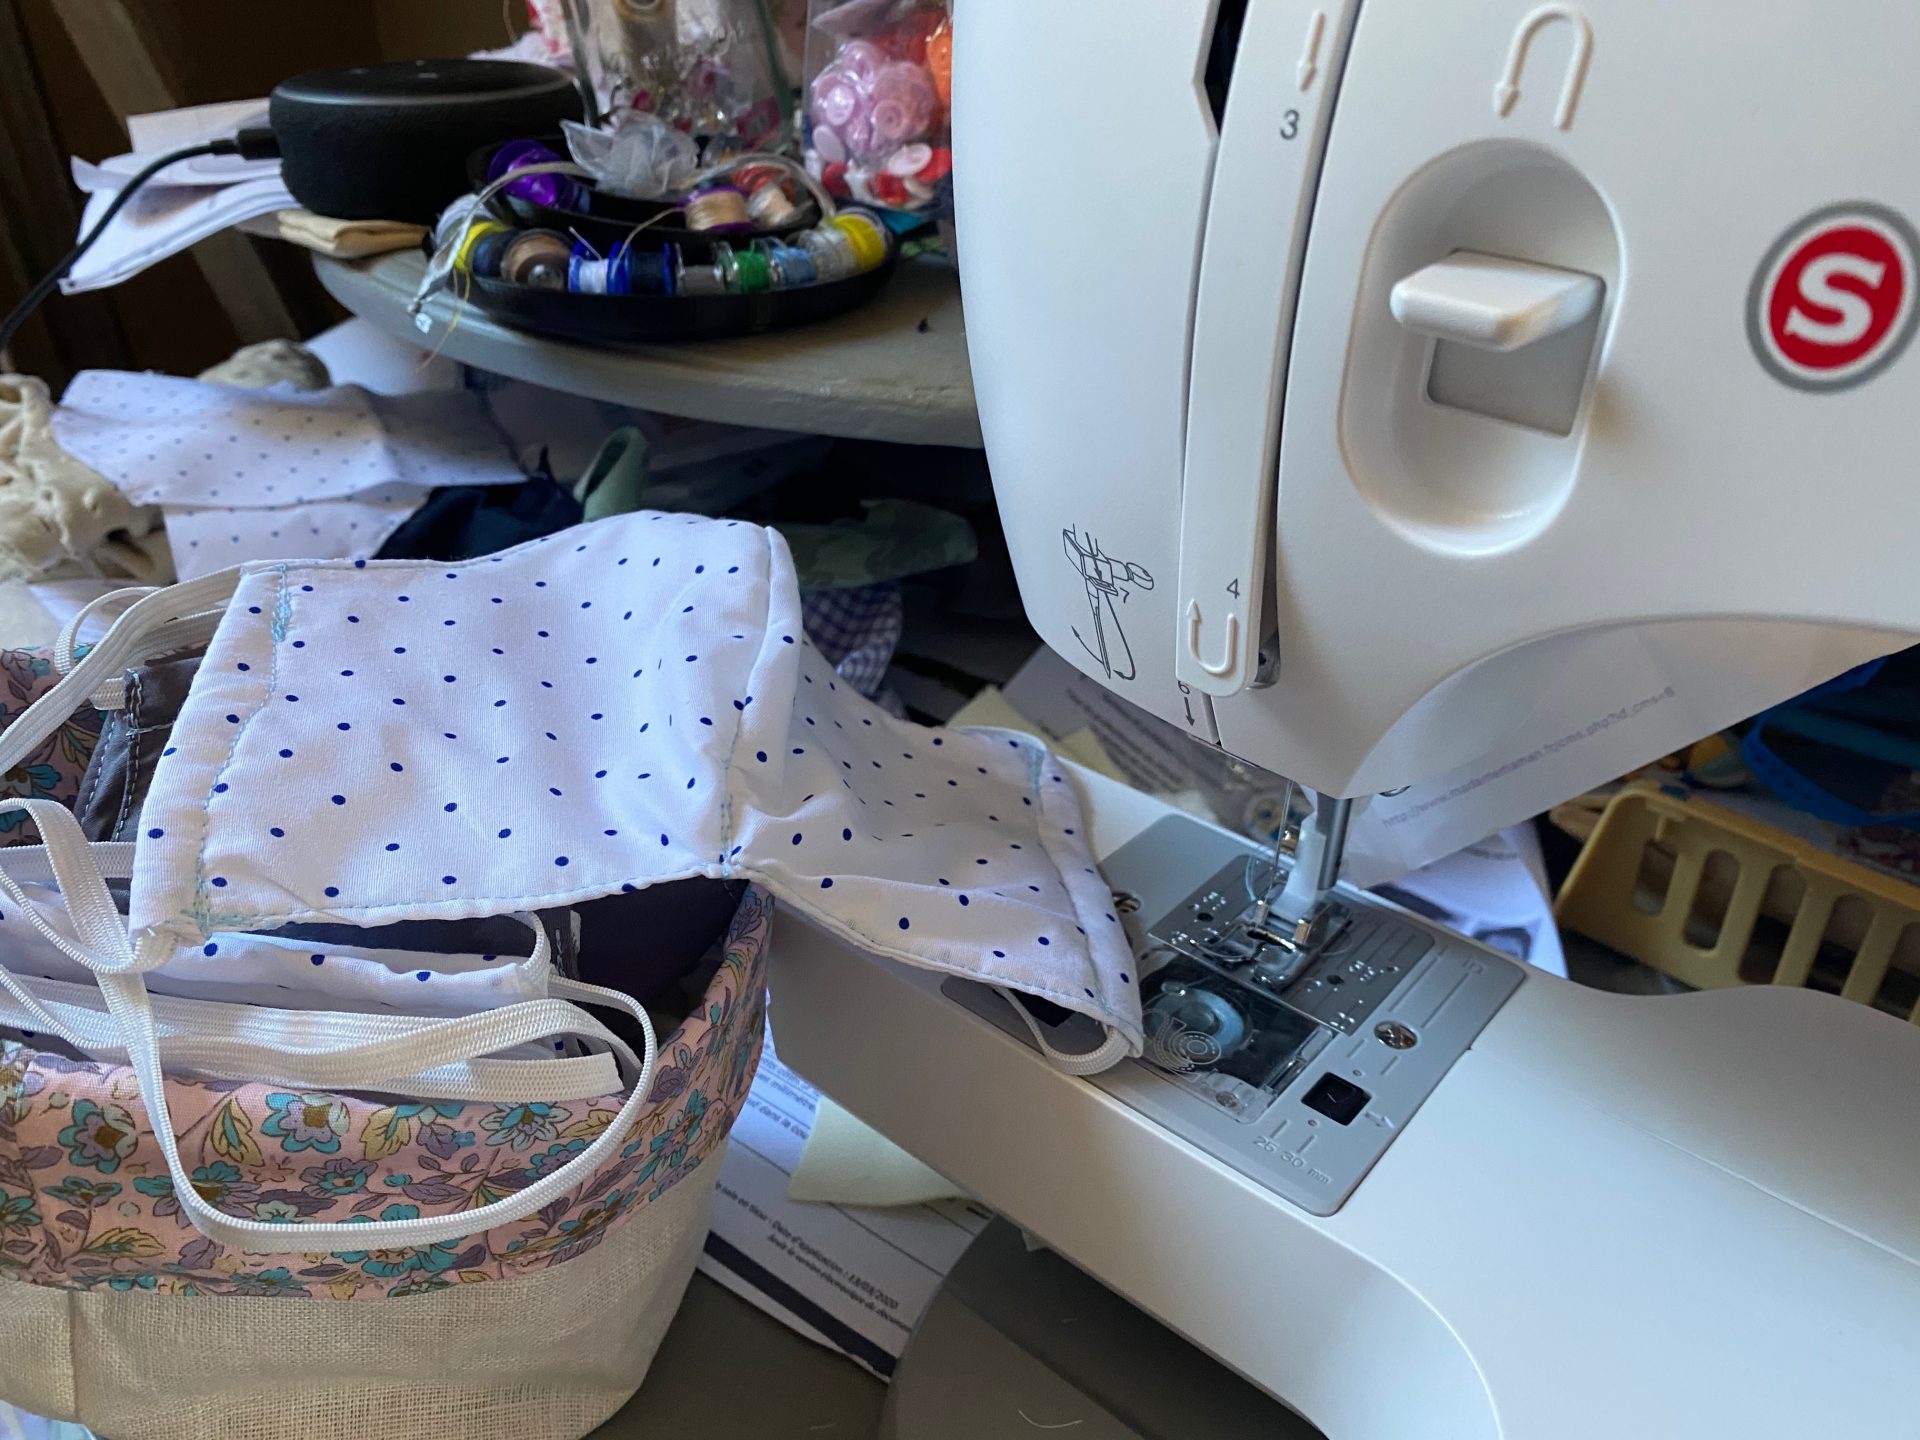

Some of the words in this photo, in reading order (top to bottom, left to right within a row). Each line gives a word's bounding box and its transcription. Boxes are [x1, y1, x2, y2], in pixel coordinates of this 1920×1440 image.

[1279, 110, 1299, 140] 3
[1782, 252, 1888, 346] S
[1119, 587, 1130, 604] 7
[1226, 578, 1240, 599] 4
[1252, 1135, 1278, 1153] 25
[1280, 1151, 1306, 1168] 30
